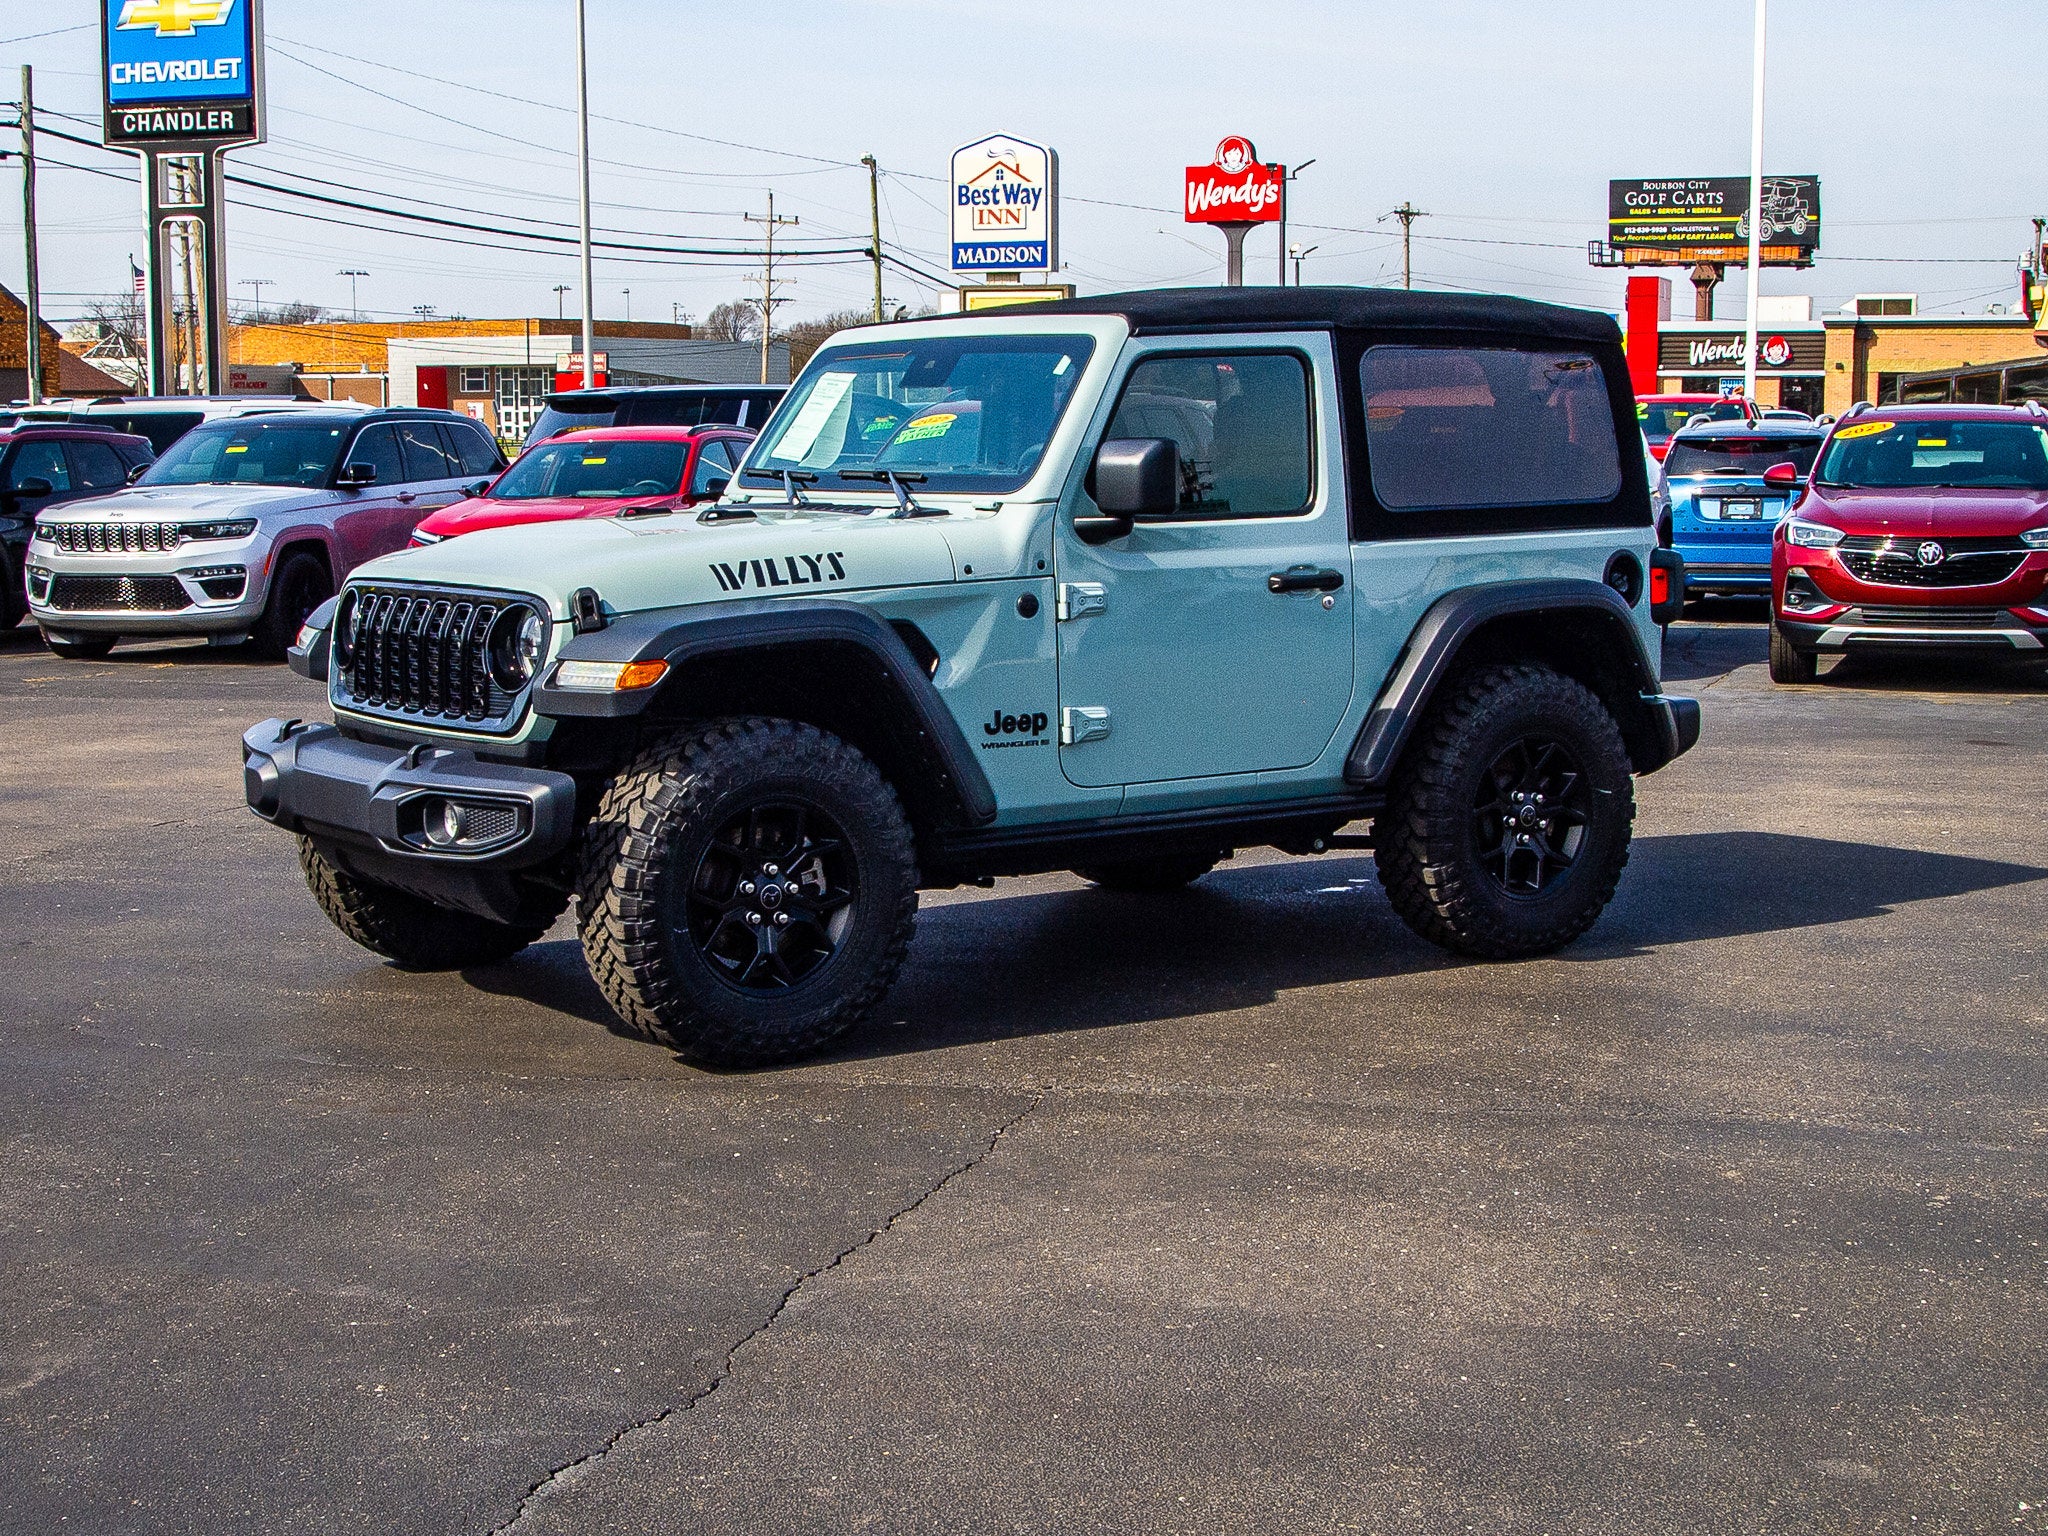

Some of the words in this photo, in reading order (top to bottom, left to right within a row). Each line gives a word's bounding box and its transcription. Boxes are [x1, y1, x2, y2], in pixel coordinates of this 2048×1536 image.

[111, 58, 242, 84] CHEVROLET
[123, 111, 235, 133] CHANDLER
[958, 184, 999, 206] Best
[1002, 183, 1042, 211] Way
[1187, 173, 1279, 214] Wendy's
[1625, 191, 1666, 206] GOLF
[1672, 190, 1724, 205] CARTS
[978, 207, 1022, 225] INN
[957, 246, 1042, 265] MADISON
[1690, 335, 1759, 366] Wendy
[708, 551, 848, 591] WILLYS
[984, 710, 1048, 736] Jeep
[981, 740, 1039, 749] WRANGLER
